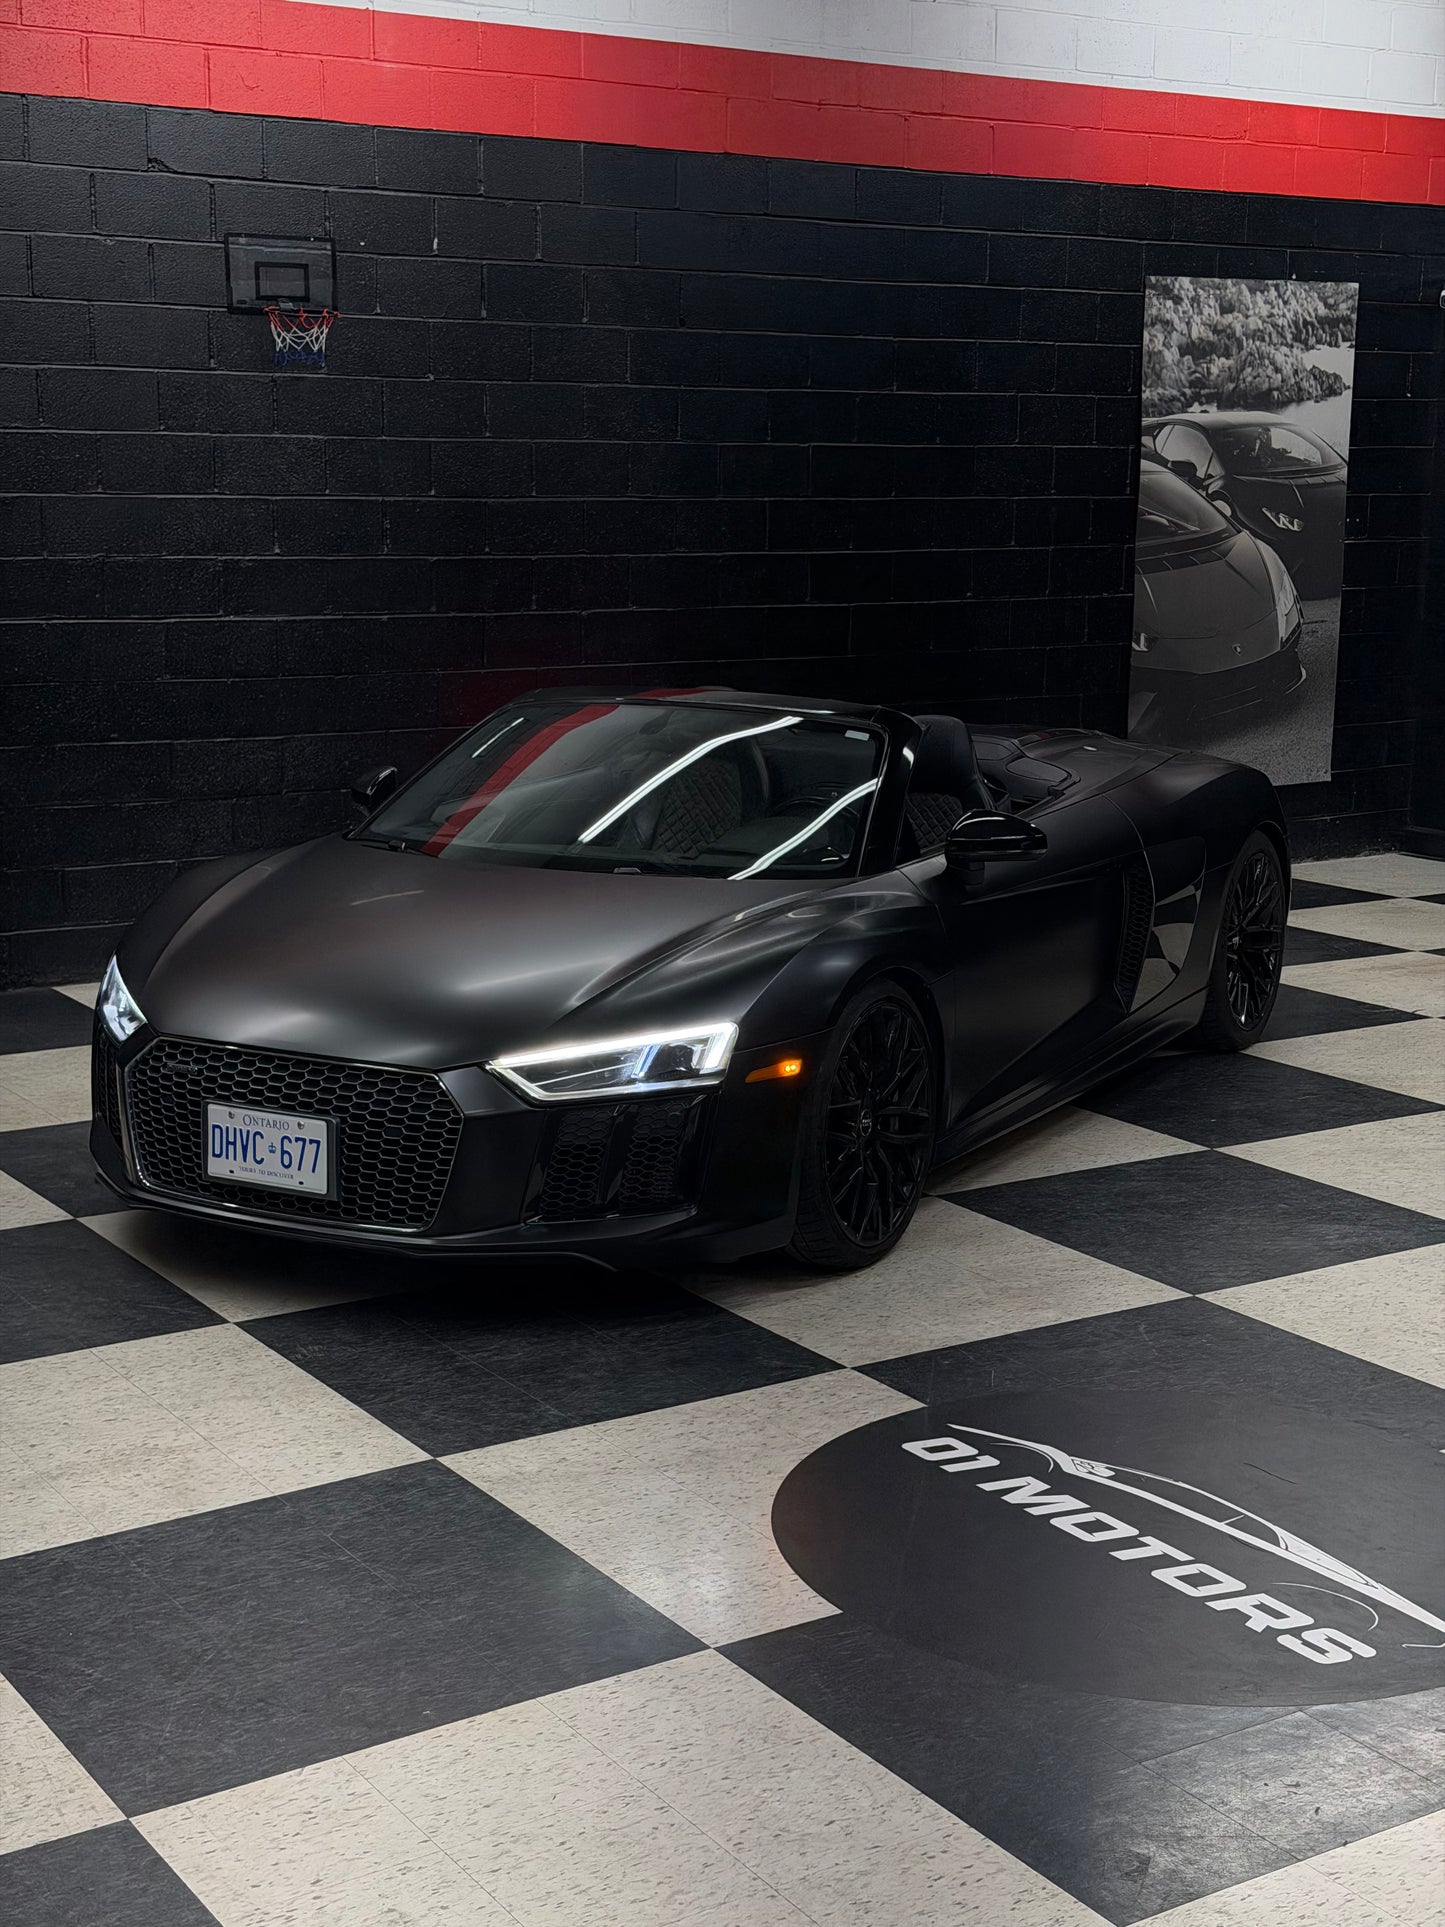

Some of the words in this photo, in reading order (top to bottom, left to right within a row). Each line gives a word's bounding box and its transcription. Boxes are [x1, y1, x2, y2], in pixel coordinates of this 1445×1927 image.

[243, 1114, 289, 1130] ONTARIO
[212, 1124, 264, 1165] DHVC
[281, 1135, 321, 1173] 677
[976, 1475, 1377, 1665] MOTORS
